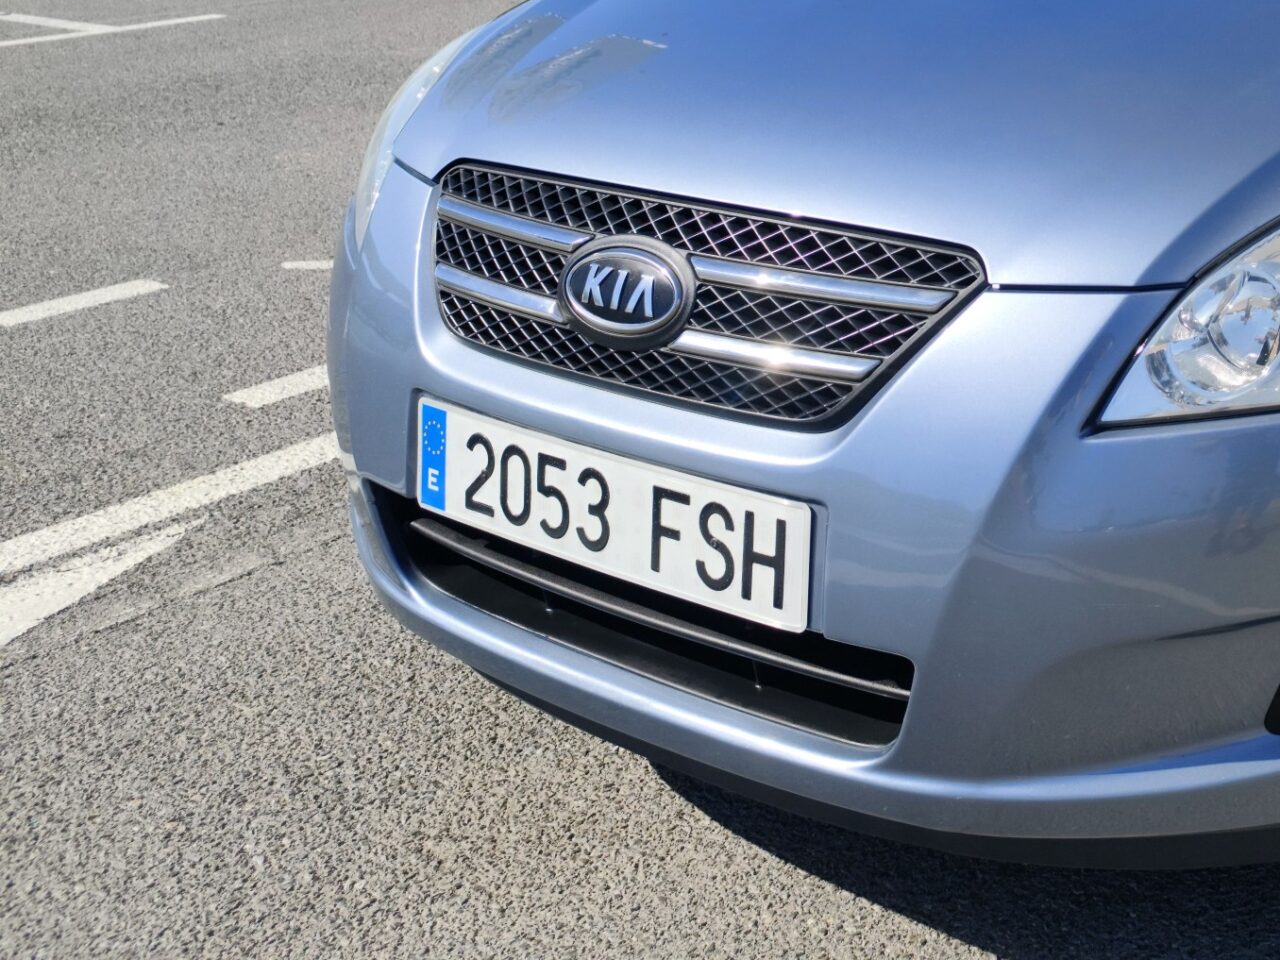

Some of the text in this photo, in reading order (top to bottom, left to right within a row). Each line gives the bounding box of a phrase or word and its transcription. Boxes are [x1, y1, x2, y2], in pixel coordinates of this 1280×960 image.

[581, 263, 655, 318] KIA
[427, 467, 440, 492] E
[465, 432, 786, 610] 2053 FSH
